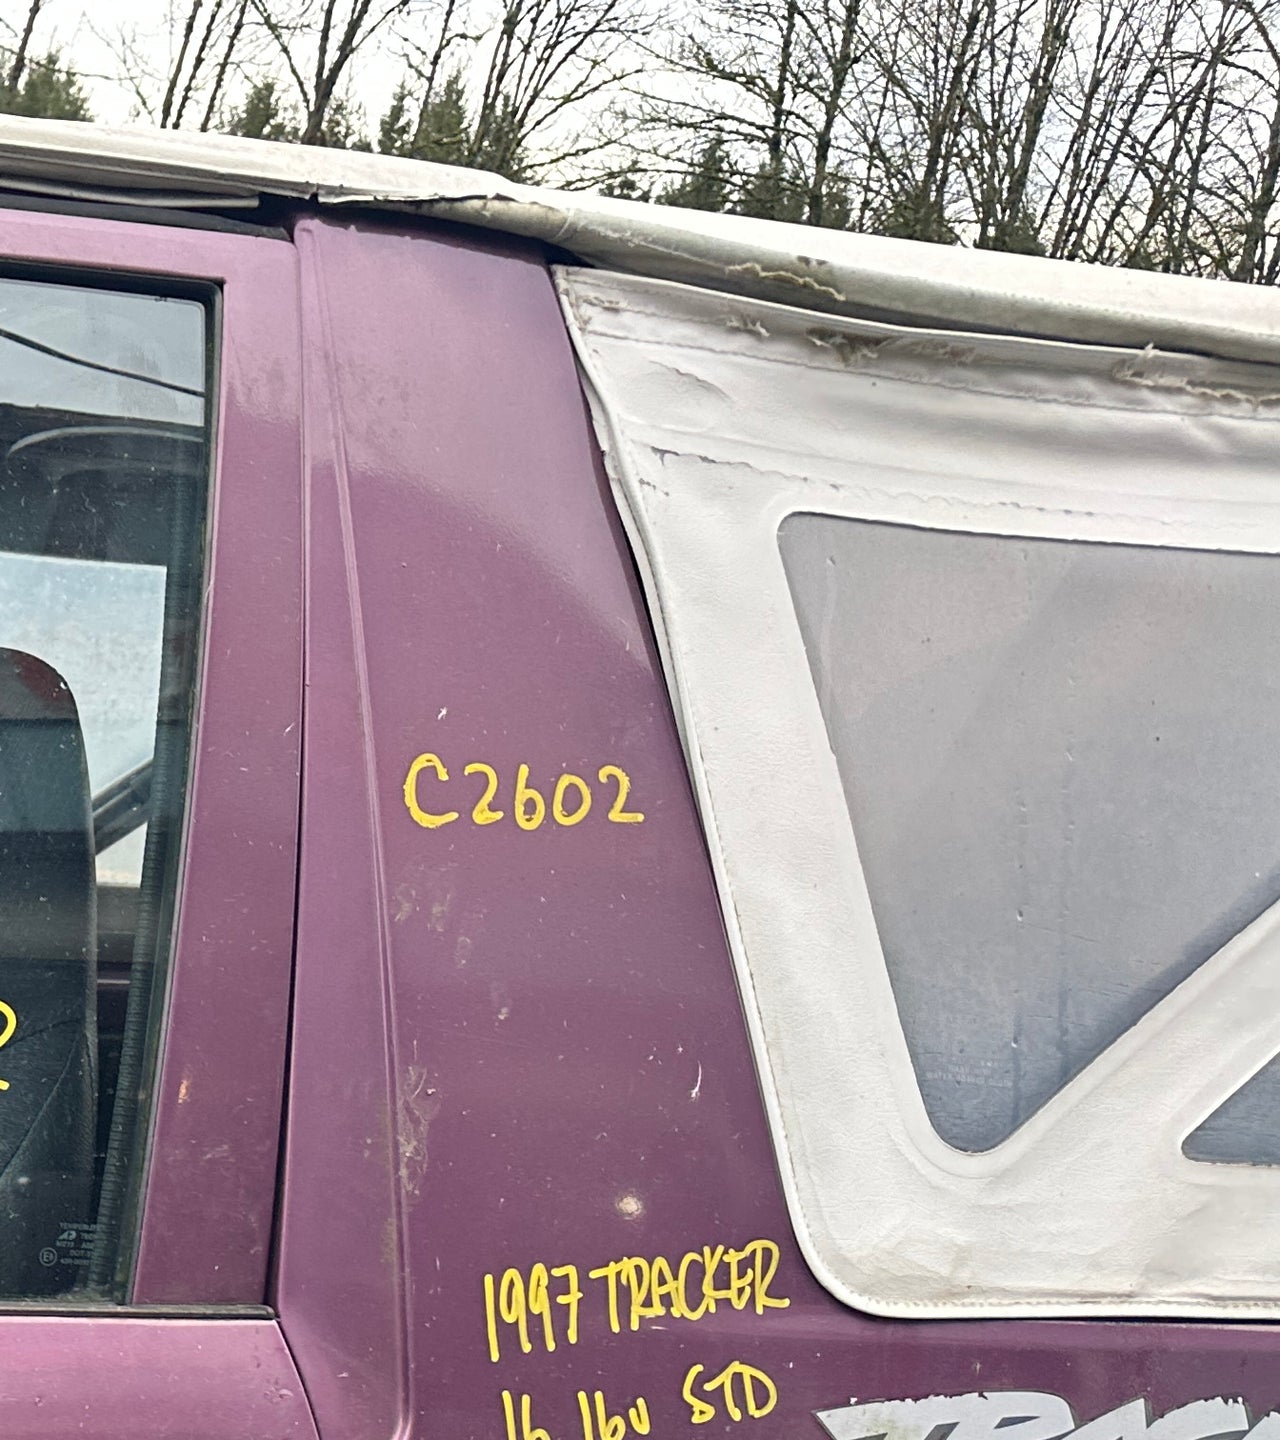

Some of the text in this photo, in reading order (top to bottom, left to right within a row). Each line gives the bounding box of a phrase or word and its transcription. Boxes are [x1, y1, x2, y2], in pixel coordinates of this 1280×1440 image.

[403, 753, 644, 830] C2602
[484, 1239, 790, 1362] 1997 TRACKER
[682, 1361, 778, 1424] STD
